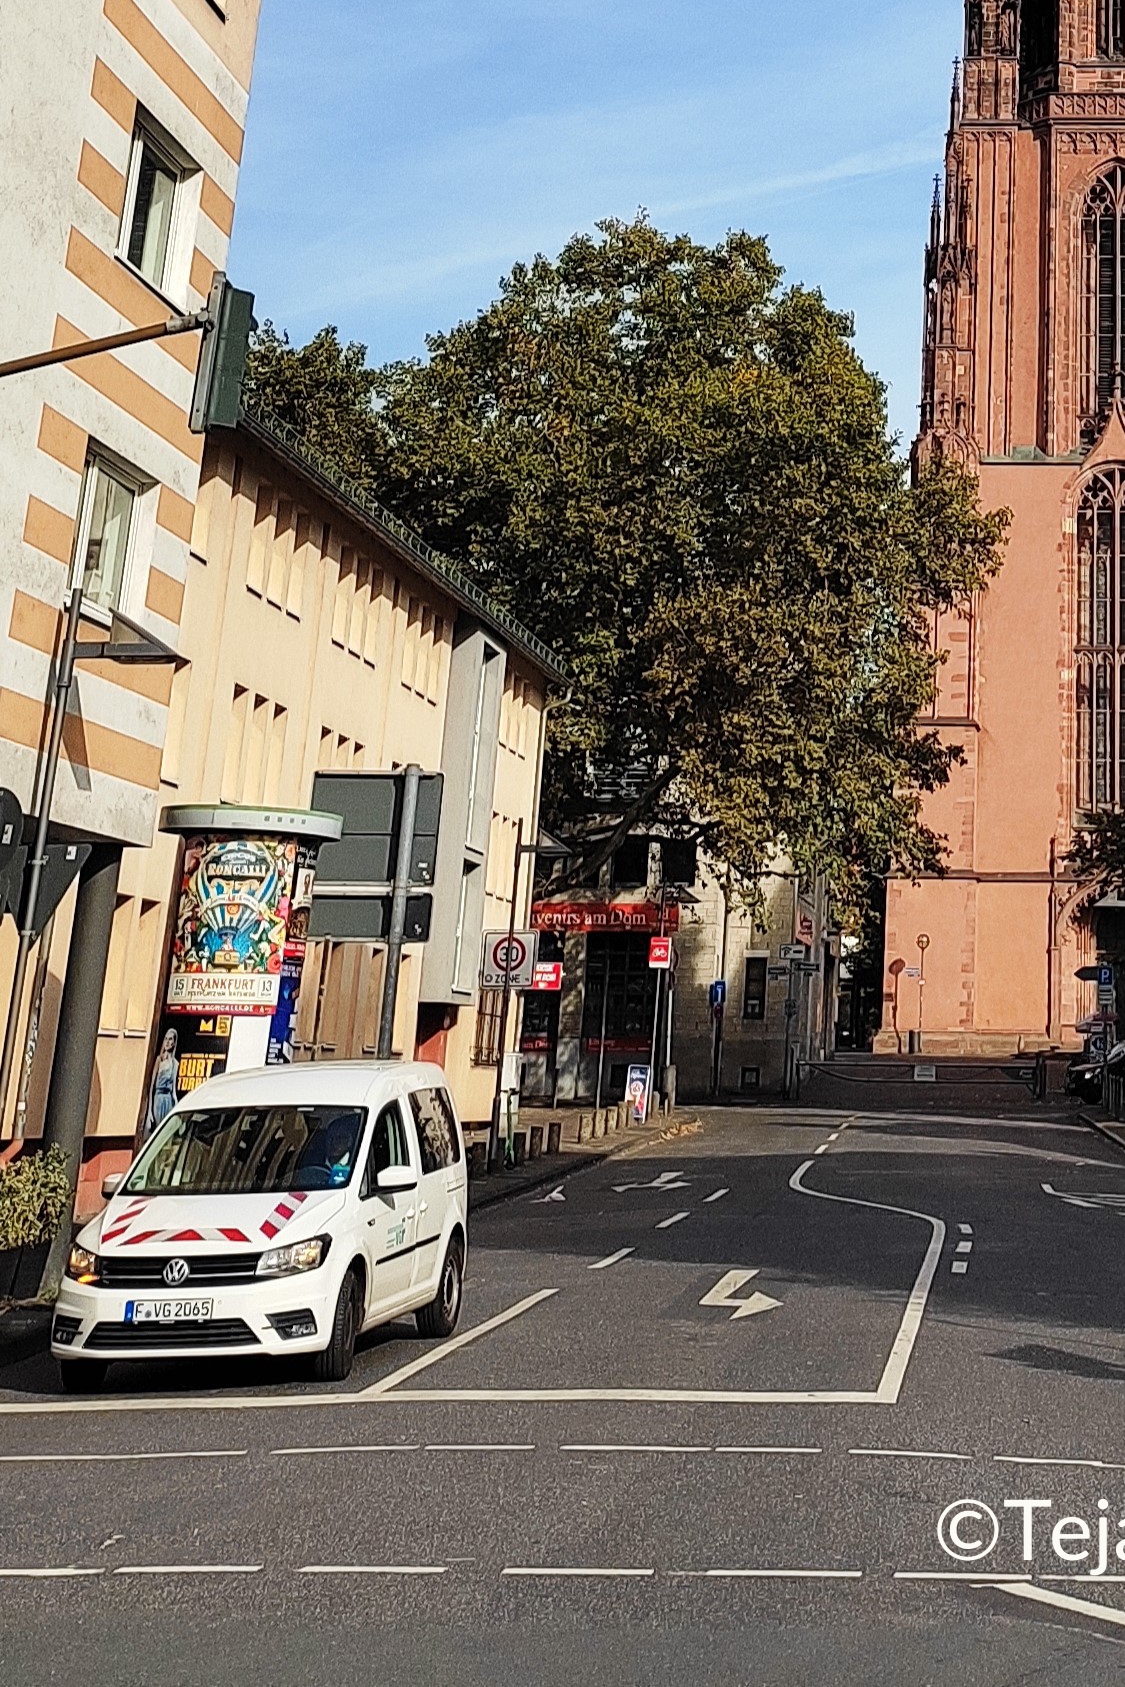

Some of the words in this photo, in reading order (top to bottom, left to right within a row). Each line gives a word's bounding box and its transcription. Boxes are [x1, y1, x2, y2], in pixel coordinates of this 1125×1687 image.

[208, 863, 267, 877] RONCALLI
[584, 912, 606, 925] am
[499, 946, 519, 962] 30
[1101, 968, 1110, 983] P
[191, 978, 256, 991] FRANKFURT
[135, 1303, 144, 1318] F
[154, 1302, 171, 1318] VG
[174, 1301, 210, 1317] 2065
